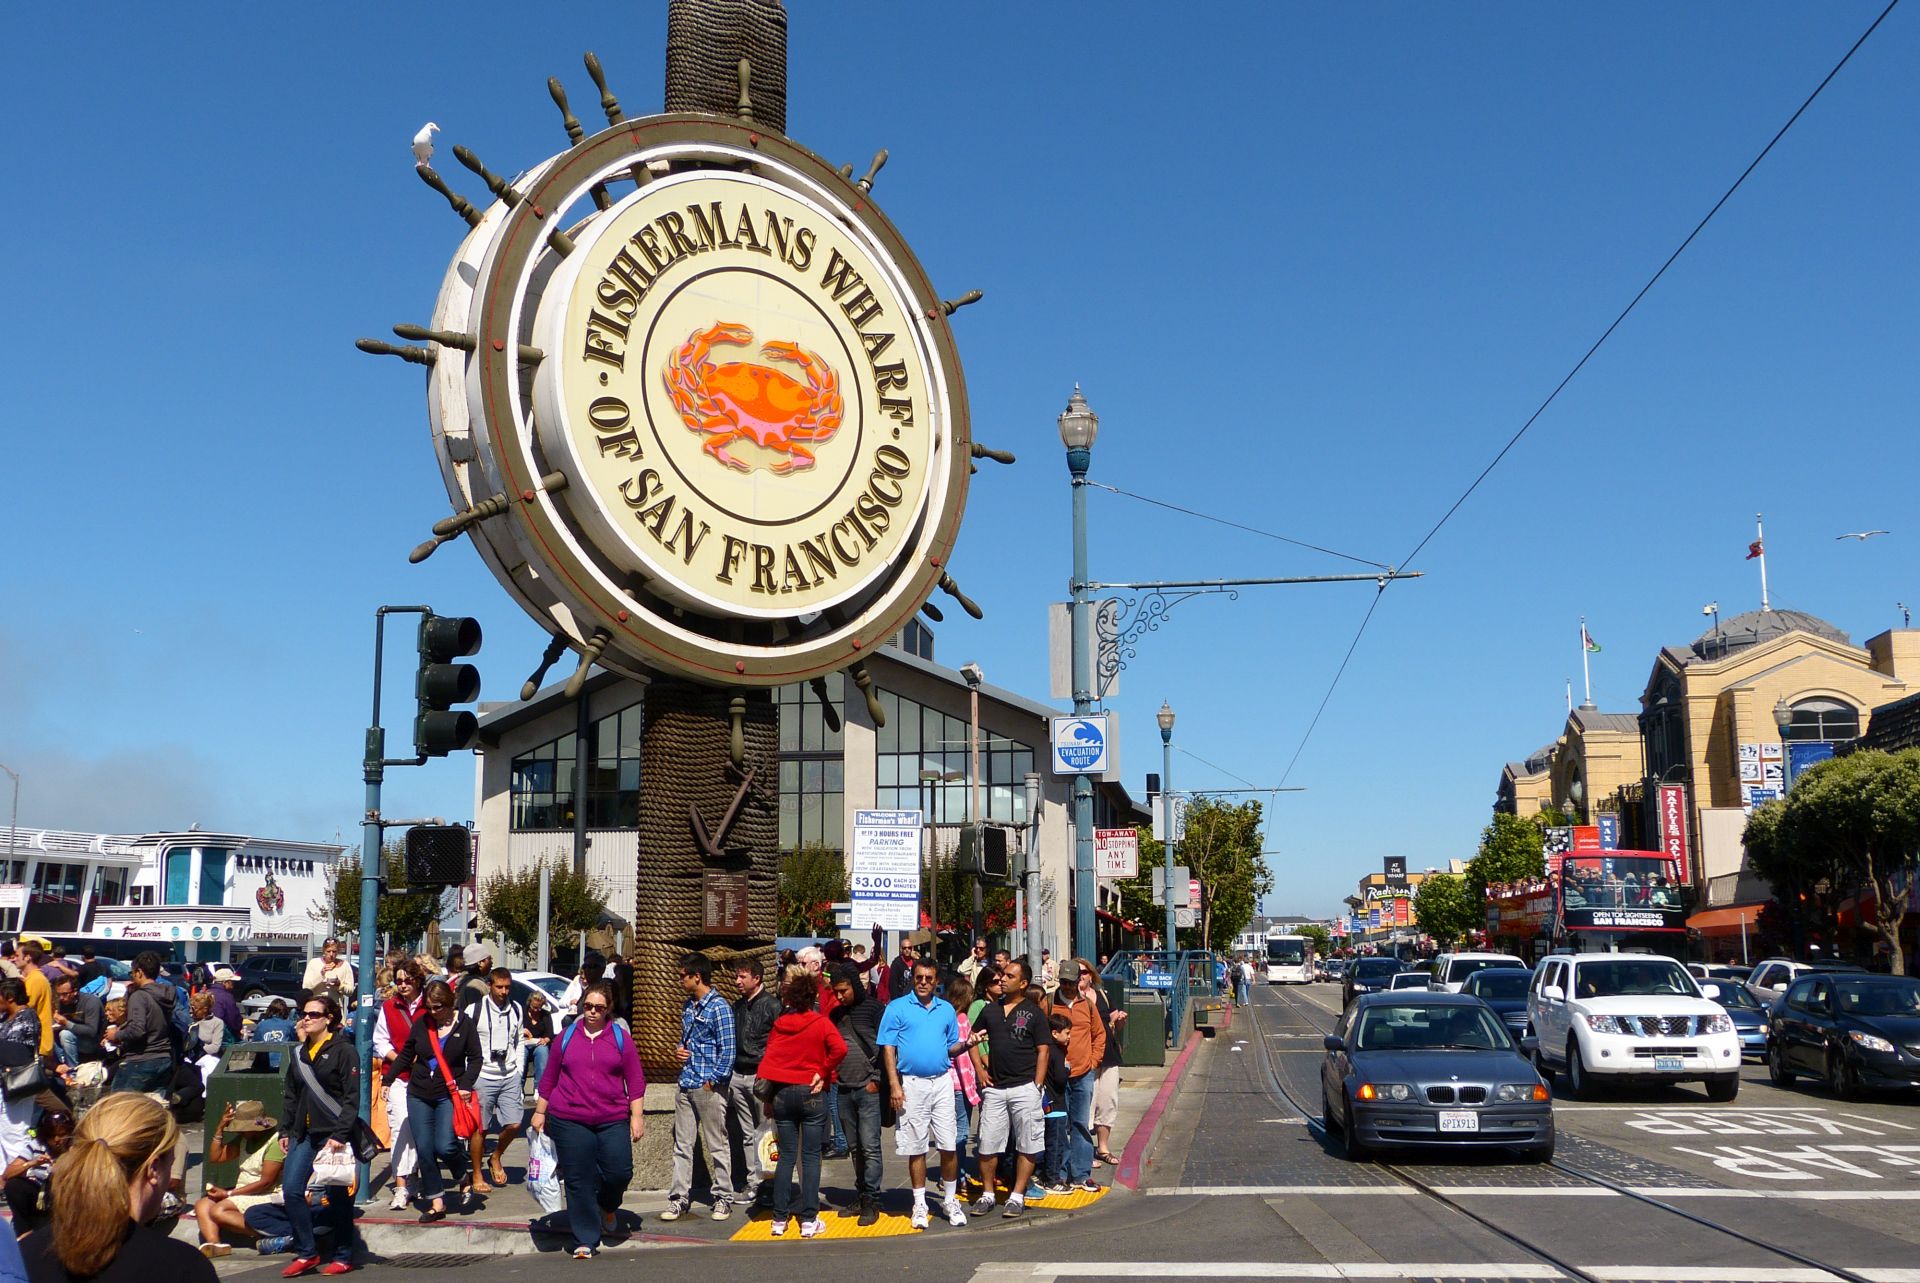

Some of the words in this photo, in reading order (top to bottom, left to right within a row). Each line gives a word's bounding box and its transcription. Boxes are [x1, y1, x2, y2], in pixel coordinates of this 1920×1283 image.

[583, 200, 817, 371] FISHERMANS
[819, 246, 915, 428] WHARF
[588, 396, 643, 462] OF
[619, 467, 712, 565] SAN
[716, 443, 912, 593] FRANCISCO
[1061, 747, 1100, 757] EVACUATION
[1070, 756, 1091, 765] ROUTE
[897, 813, 918, 825] Wharf
[879, 830, 900, 838] HOURS
[1097, 830, 1134, 838] TOW-AWAY
[1602, 820, 1612, 842] WAX
[869, 838, 905, 846] PARKING
[1096, 838, 1107, 849] NO
[1108, 840, 1135, 849] STOPPING
[1108, 850, 1125, 860] ANY
[236, 854, 314, 872] RANCISCAN
[1106, 860, 1127, 869] TIME
[855, 877, 892, 888] $3.00
[1367, 885, 1411, 900] Radison
[1614, 918, 1664, 927] FRANCISCO
[253, 932, 308, 940] RESTAURAN
[1016, 1010, 1033, 1020] NYC
[1442, 1118, 1476, 1129] 6PIX913
